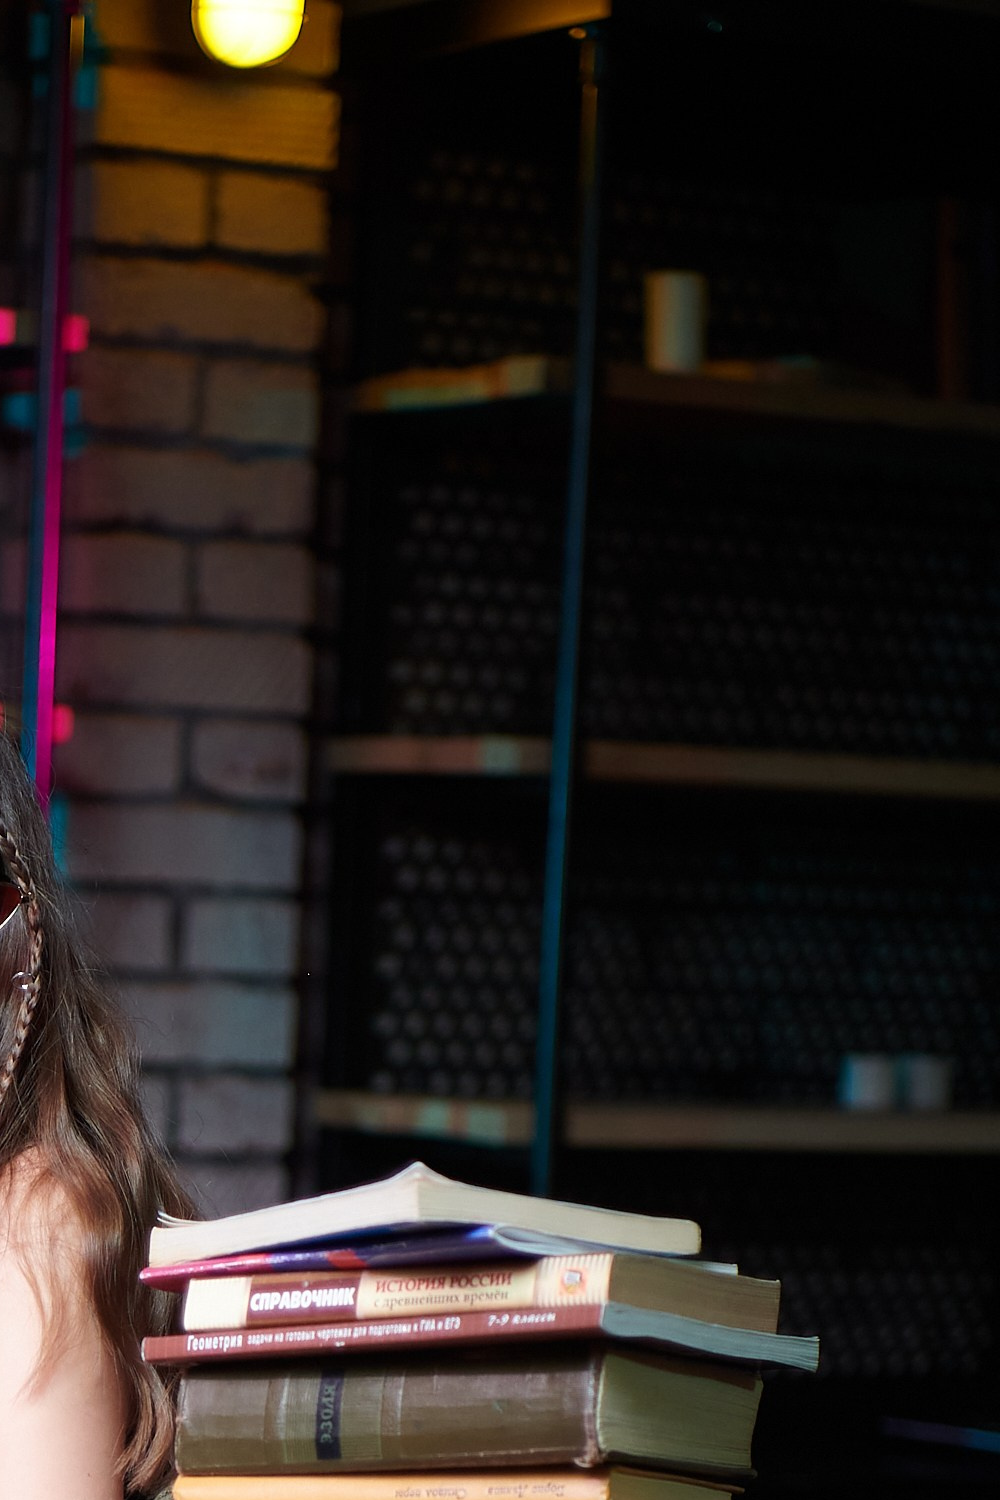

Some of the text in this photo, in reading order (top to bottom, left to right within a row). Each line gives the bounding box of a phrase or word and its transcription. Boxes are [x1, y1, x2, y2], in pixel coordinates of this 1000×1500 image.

[375, 1271, 513, 1293] ИСТОРИЯ РОССИИ
[250, 1287, 356, 1312] СПРАВОЧНИК
[382, 1294, 460, 1312] древнейших
[463, 1290, 509, 1307] времён
[187, 1334, 243, 1352] Геометрия
[420, 1318, 436, 1332] ГИА
[444, 1316, 461, 1331] ЕГЭ
